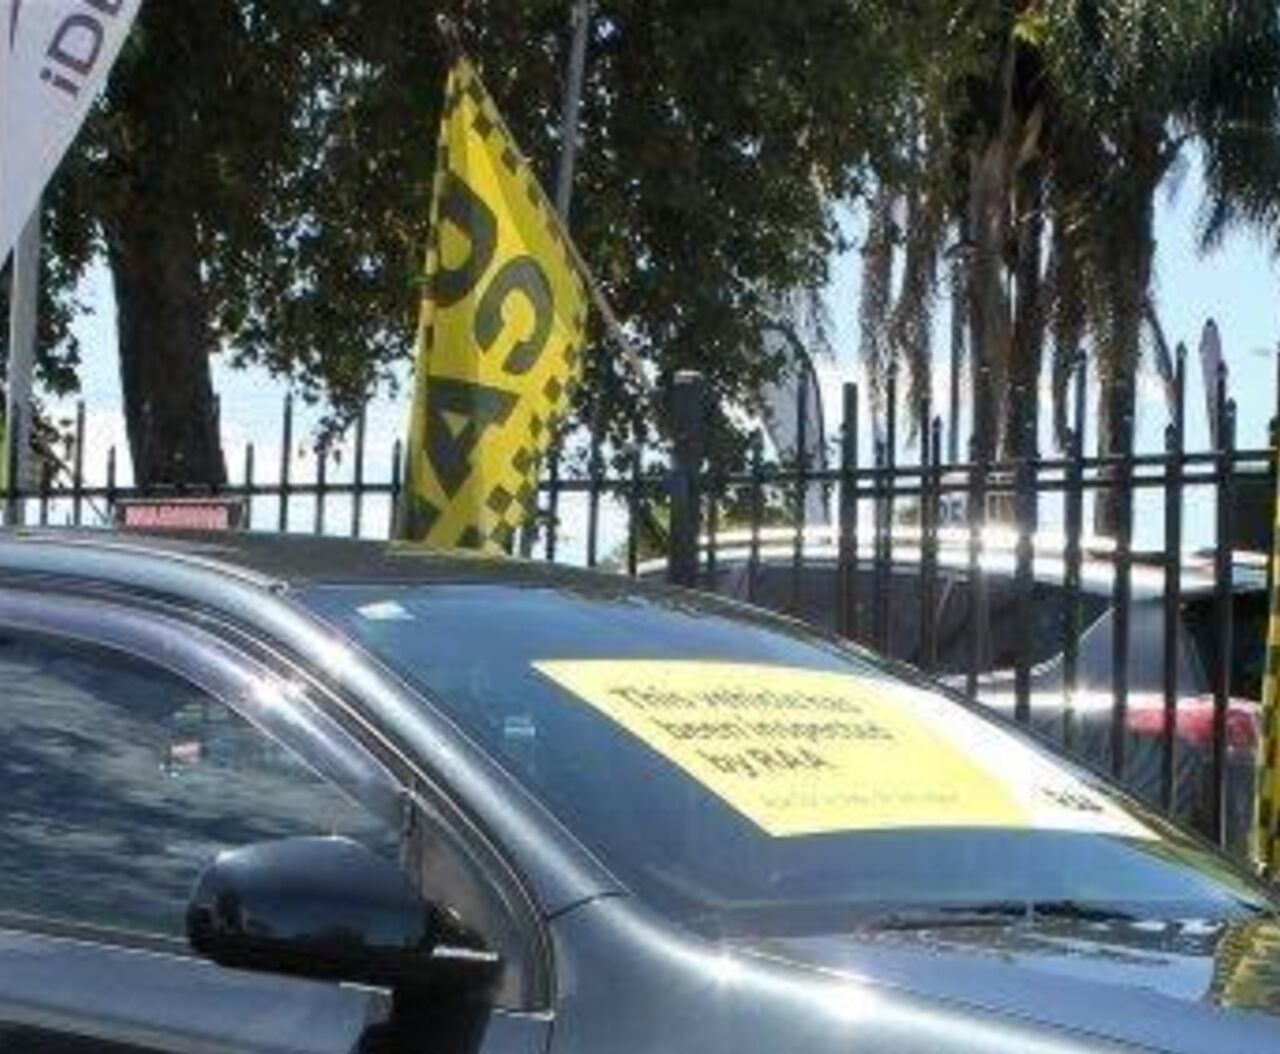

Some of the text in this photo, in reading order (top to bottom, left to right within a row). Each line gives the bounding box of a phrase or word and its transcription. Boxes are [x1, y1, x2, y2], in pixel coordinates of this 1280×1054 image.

[609, 683, 697, 711] This
[649, 716, 754, 741] been
[695, 748, 759, 779] by
